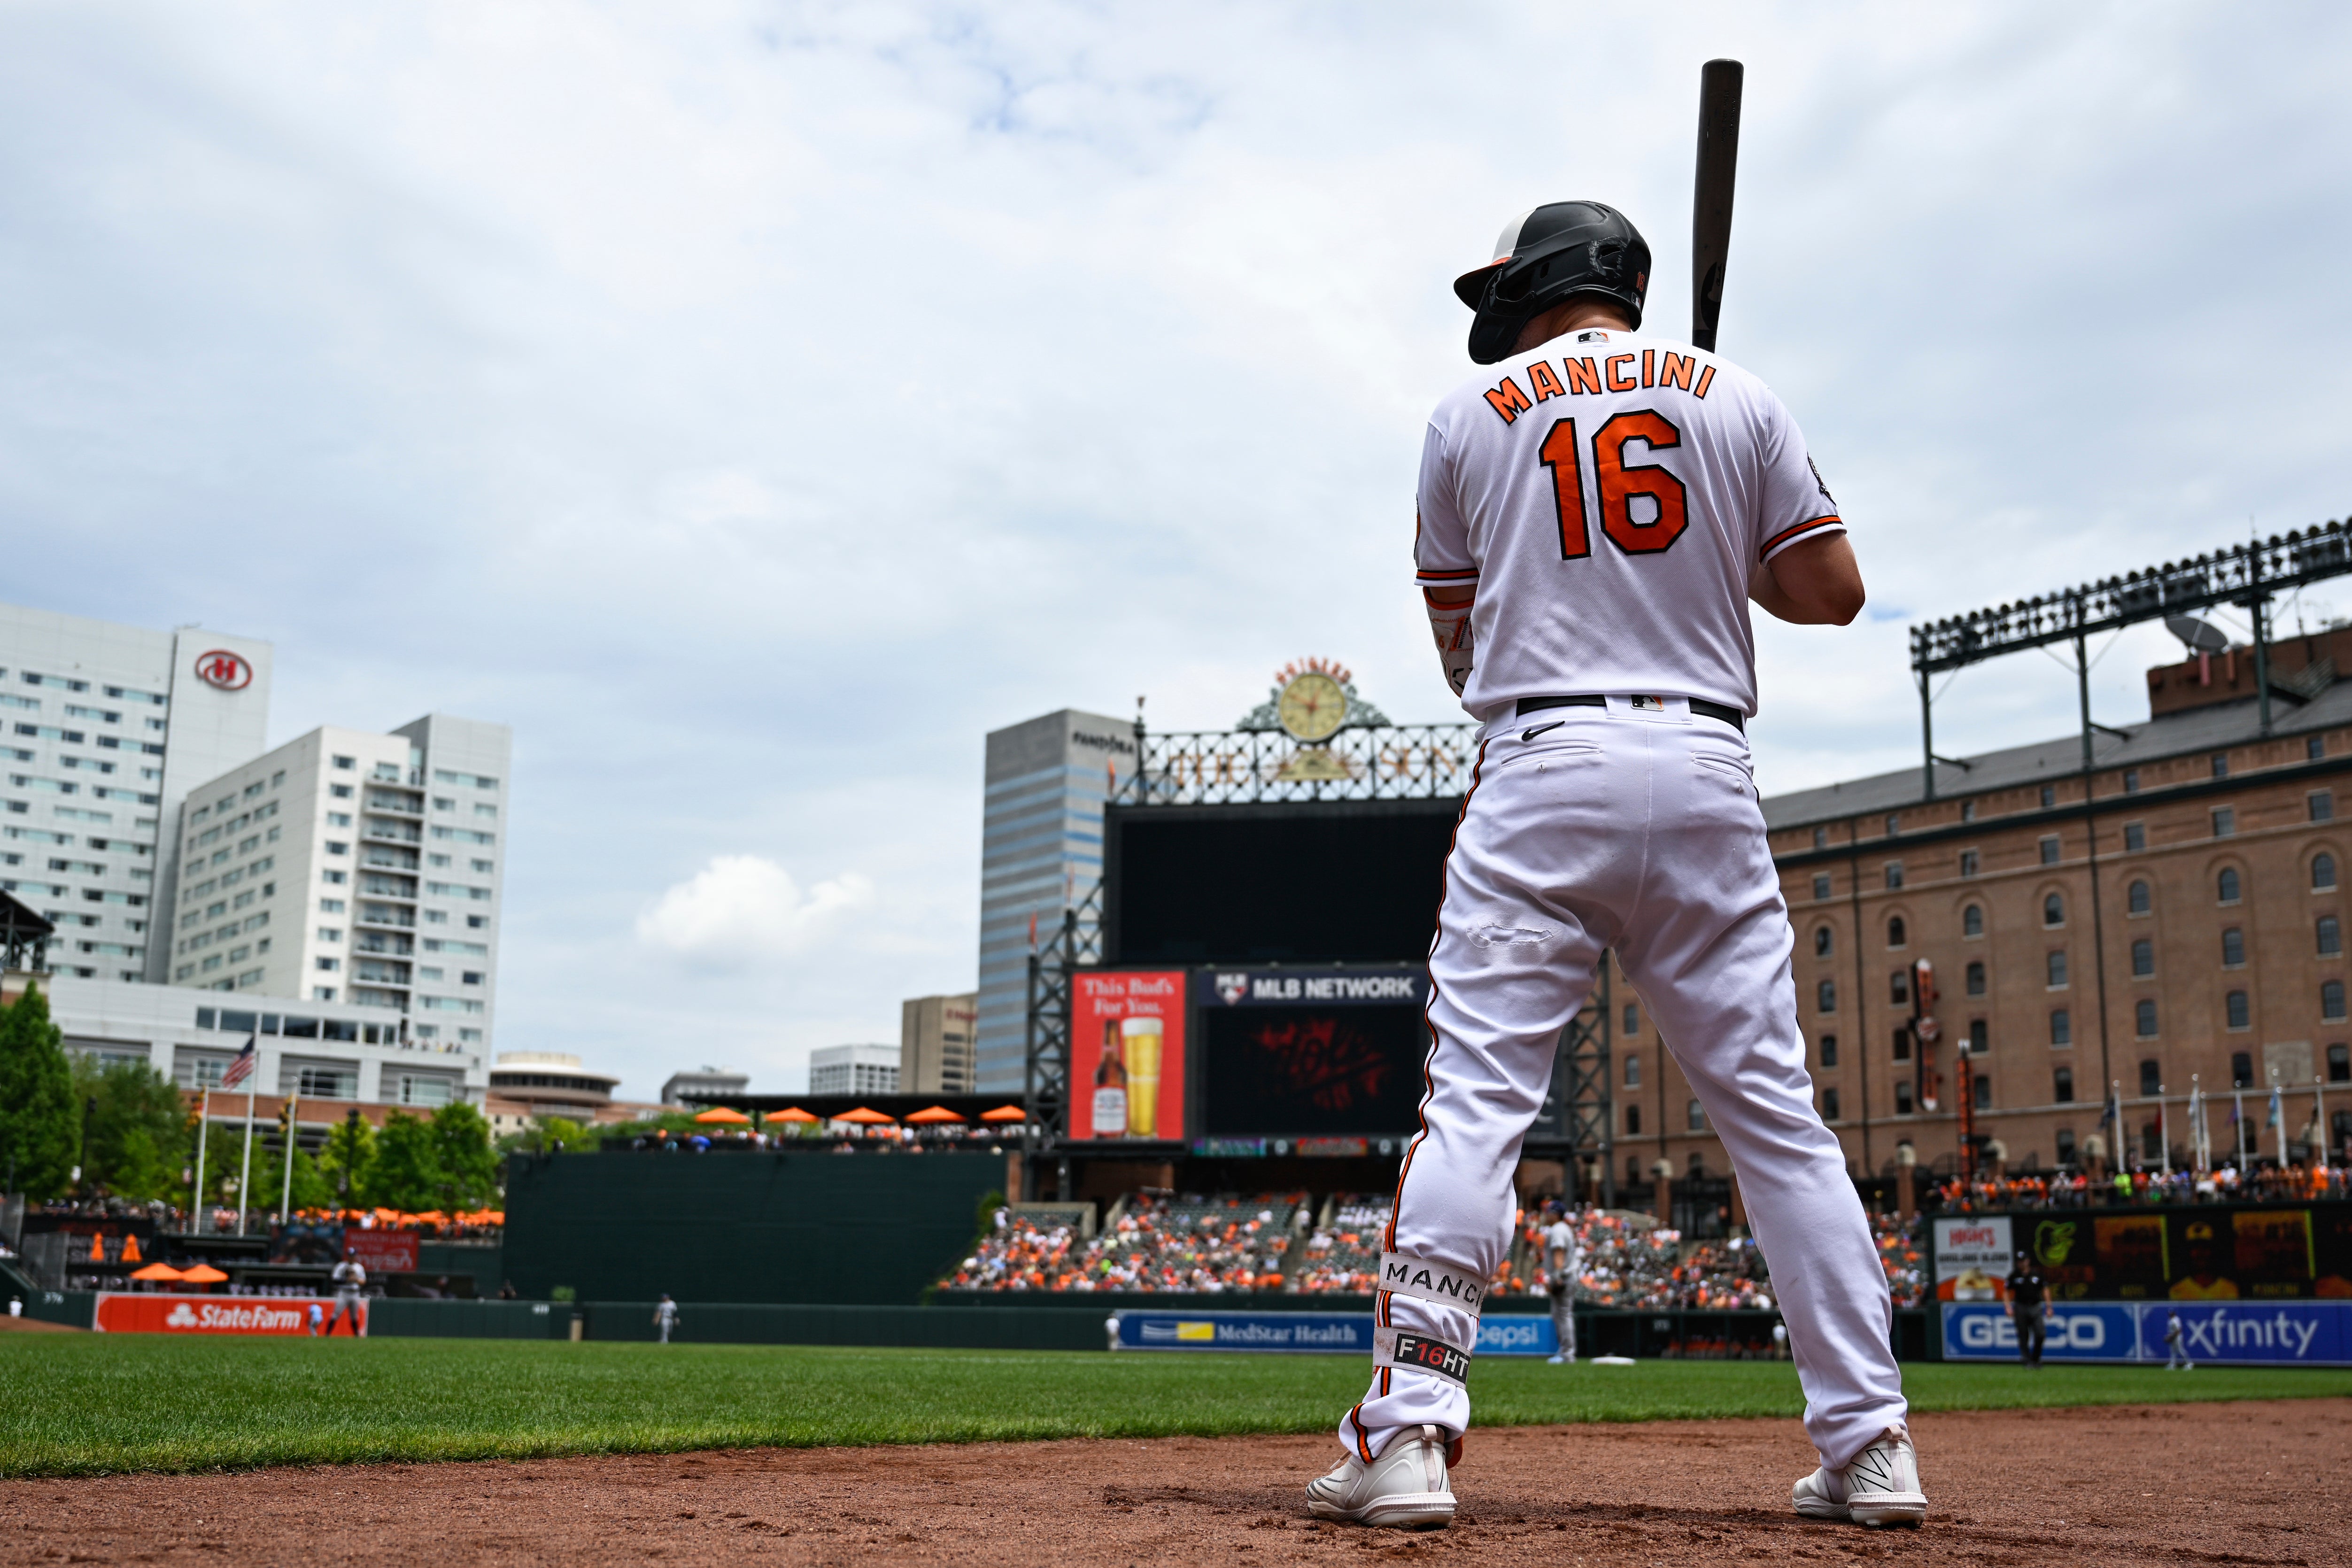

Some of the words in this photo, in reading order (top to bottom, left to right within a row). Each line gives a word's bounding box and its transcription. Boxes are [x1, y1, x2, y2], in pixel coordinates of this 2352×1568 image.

[1636, 271, 1645, 292] 16
[1483, 349, 1717, 425] MANCINI
[1538, 409, 1689, 560] 16
[1169, 753, 1250, 787] THE
[1377, 747, 1458, 780] SUN
[1083, 978, 1125, 996] This
[1130, 977, 1174, 996] Bud's
[1253, 979, 1300, 999] MLB
[1305, 977, 1415, 999] NETWORK
[1094, 998, 1124, 1016] For
[1217, 1324, 1291, 1343] MedStar
[1294, 1324, 1358, 1343] Health
[1960, 1314, 2105, 1349] GECO
[2187, 1308, 2318, 1358] xfinity
[1399, 1338, 1469, 1377] F16HT
